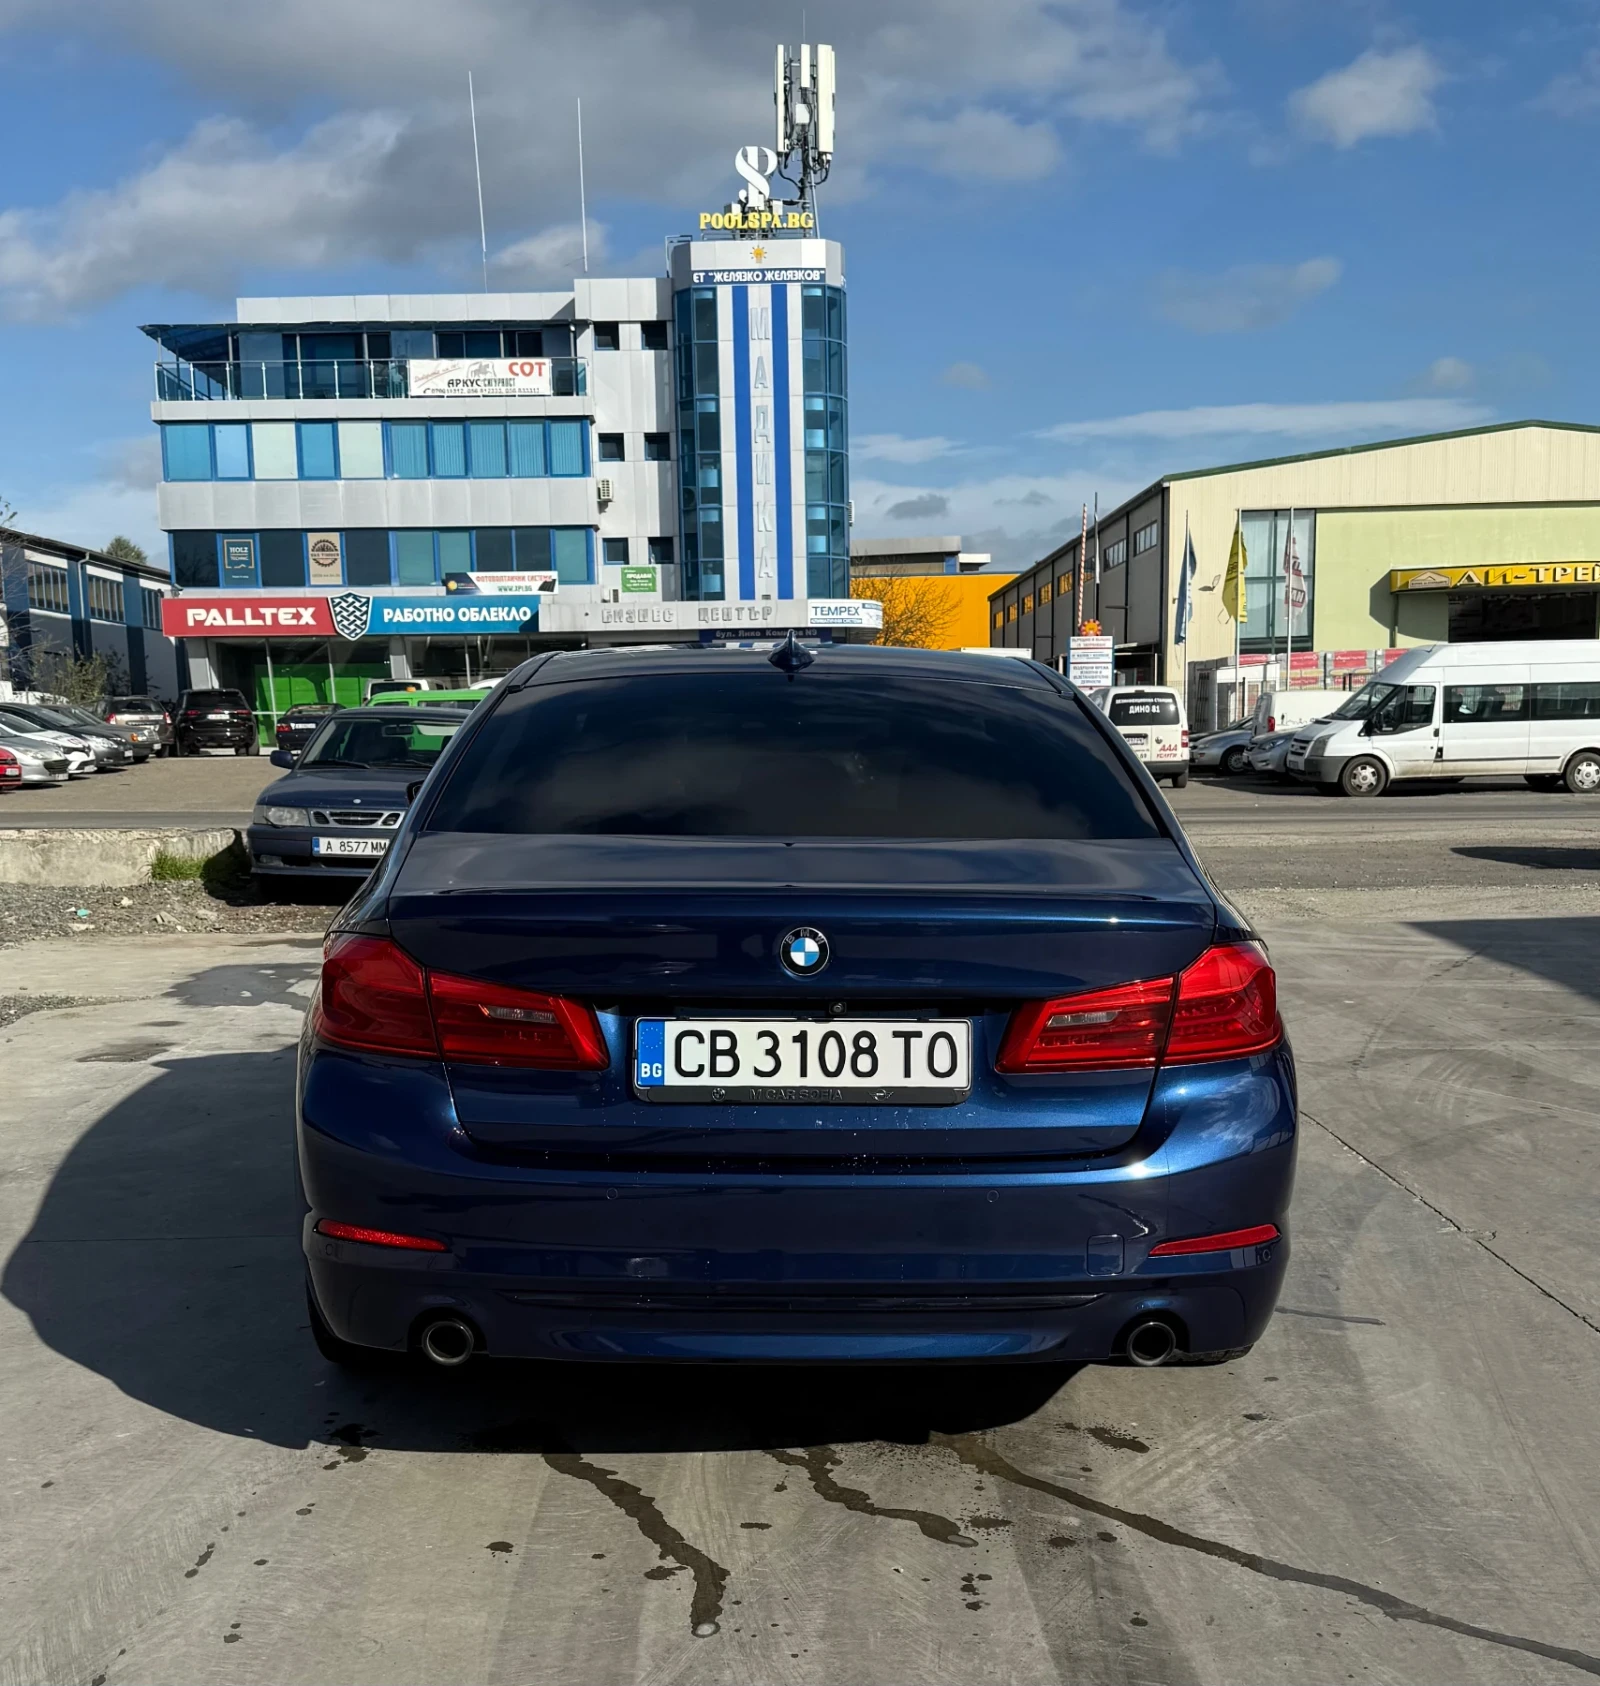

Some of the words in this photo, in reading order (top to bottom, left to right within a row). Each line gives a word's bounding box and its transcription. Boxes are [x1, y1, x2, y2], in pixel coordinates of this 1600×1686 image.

[699, 211, 815, 230] POOLSPA.BG
[692, 271, 706, 284] ЕТ
[508, 361, 547, 378] СОТ
[447, 378, 482, 388] АРКУС
[750, 307, 774, 579] МАДИКА
[186, 607, 317, 627] PALLTEX
[383, 607, 455, 623] РАБОТНО
[457, 606, 531, 622] ОБЛЕКЛО
[601, 608, 674, 624] БИЗНЕС
[698, 605, 773, 624] ЦЕНТЪР
[811, 606, 860, 616] TEMPEX
[1128, 705, 1150, 714] ДИНО
[1151, 704, 1161, 713] 81
[326, 840, 333, 852] A
[339, 840, 368, 852] 8577
[783, 929, 827, 946] BMW
[674, 1029, 741, 1078] CB
[753, 1029, 879, 1078] 3108
[891, 1030, 958, 1078] TO
[641, 1062, 663, 1078] BG
[765, 1088, 796, 1100] CAR
[799, 1088, 843, 1101] SOFIA
